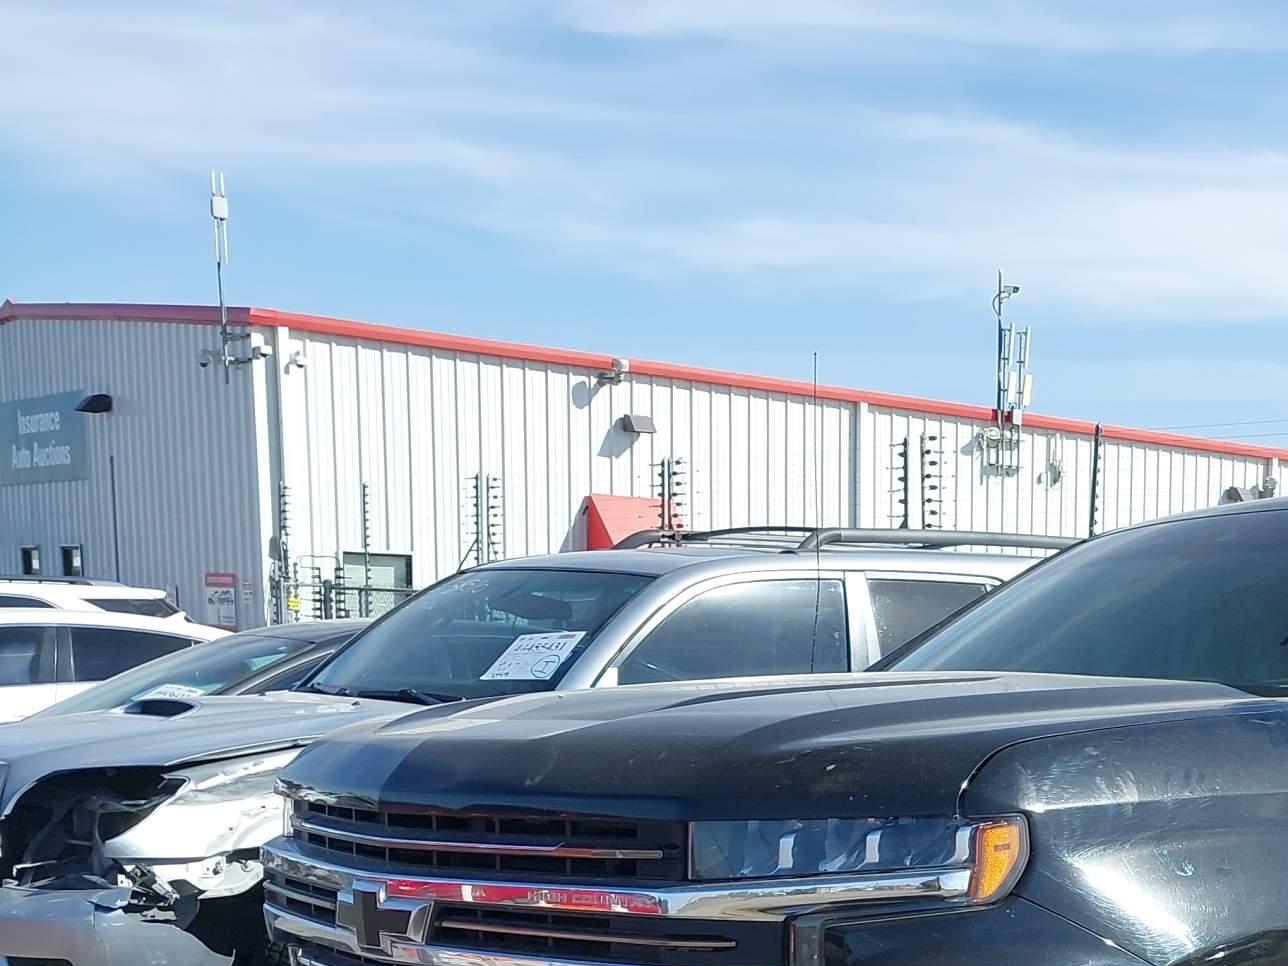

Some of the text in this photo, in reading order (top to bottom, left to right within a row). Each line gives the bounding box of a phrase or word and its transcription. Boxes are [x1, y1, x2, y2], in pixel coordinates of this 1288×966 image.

[17, 410, 60, 434] Insurance
[11, 439, 71, 470] Auto Auctions
[527, 889, 568, 904] HIGH
